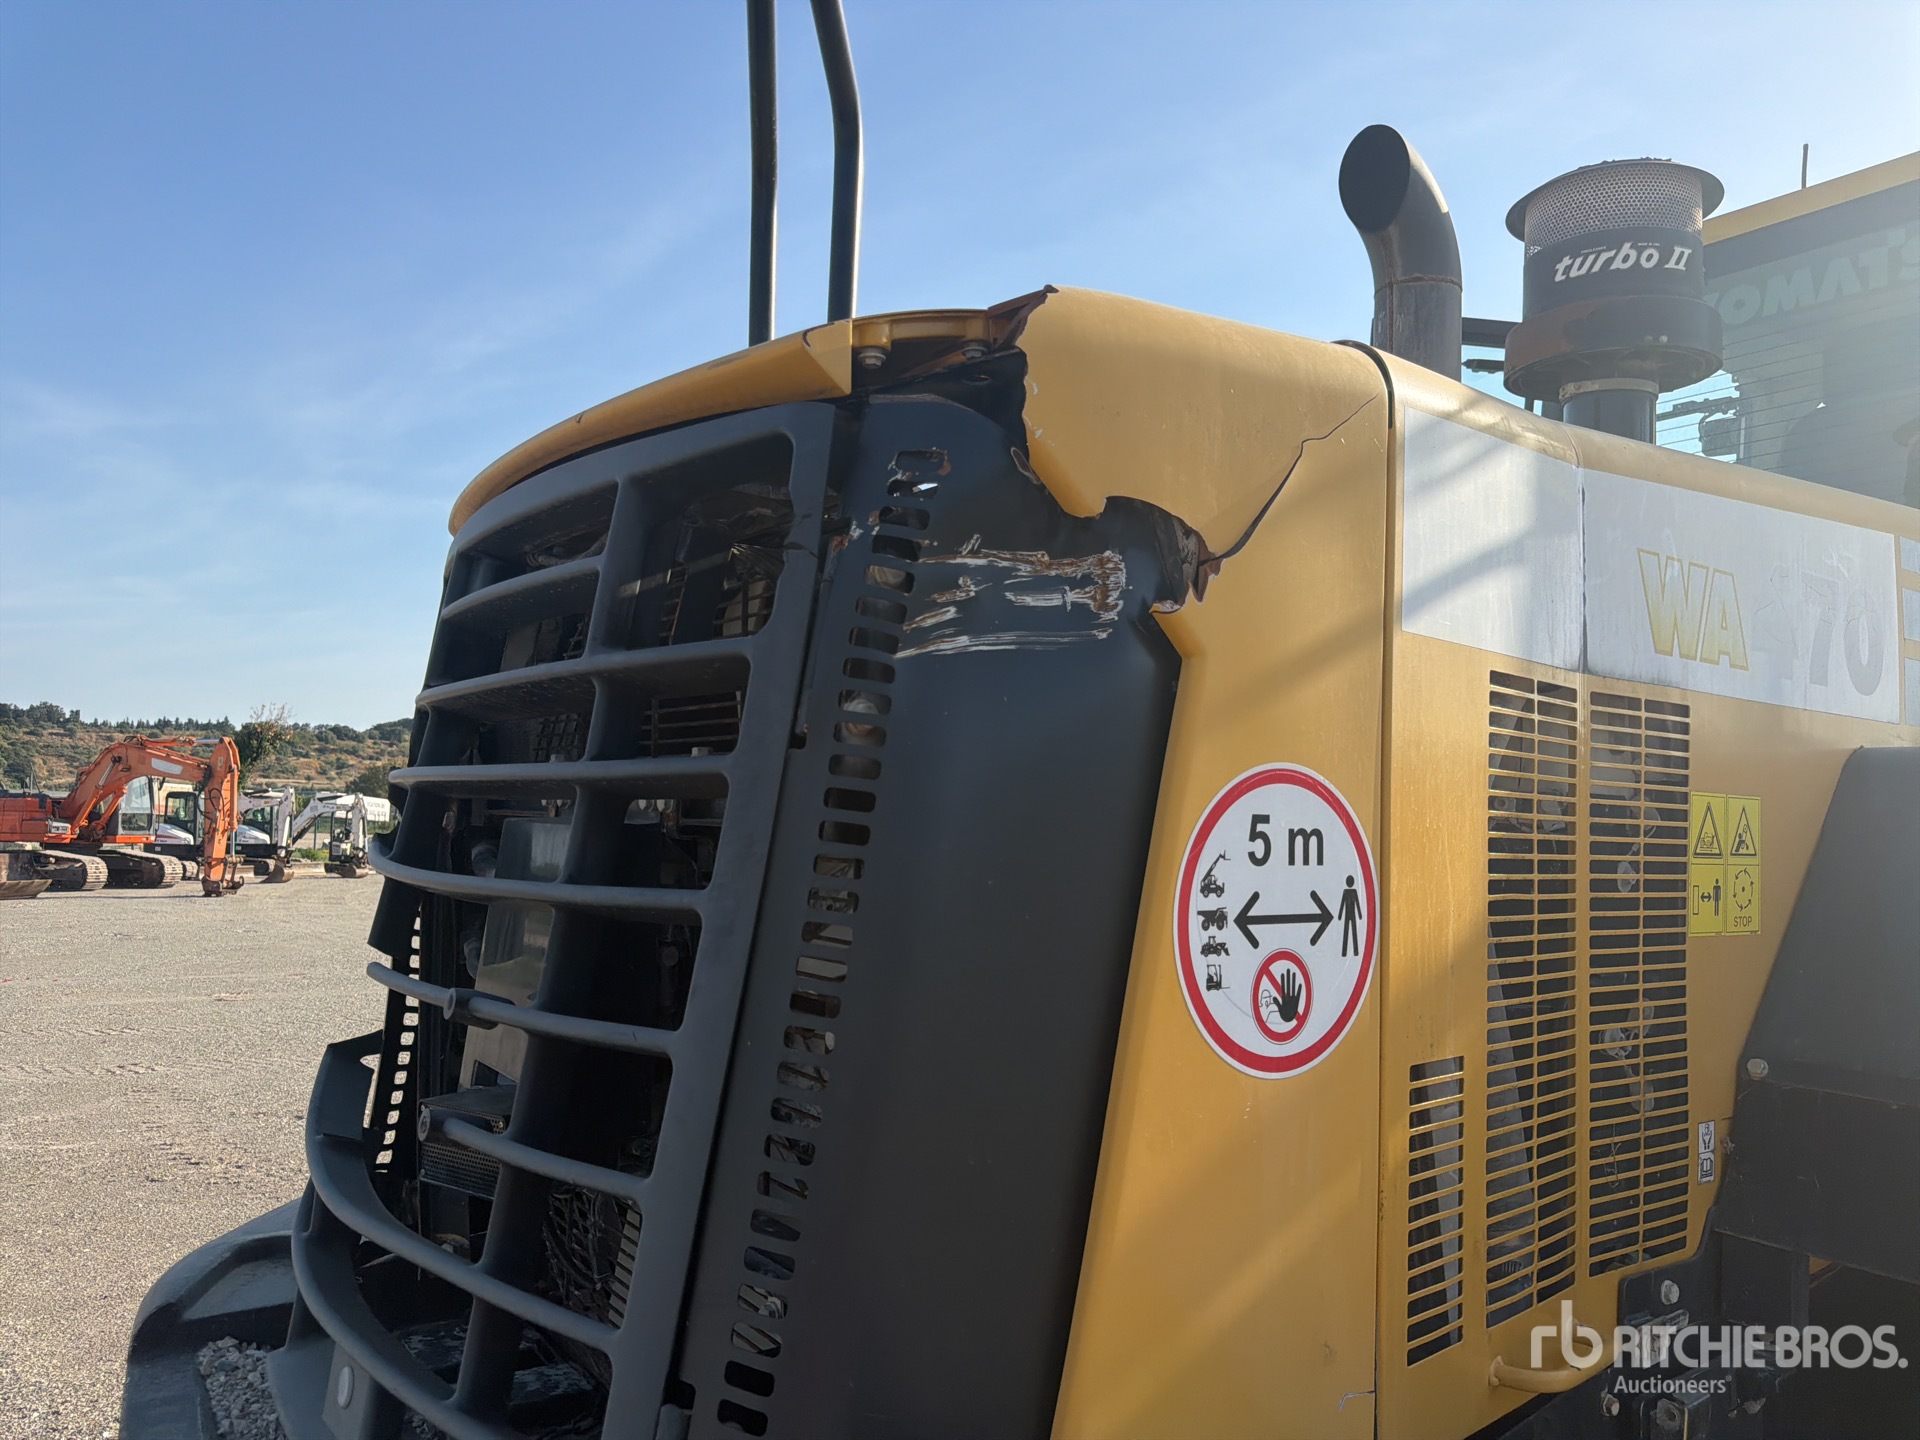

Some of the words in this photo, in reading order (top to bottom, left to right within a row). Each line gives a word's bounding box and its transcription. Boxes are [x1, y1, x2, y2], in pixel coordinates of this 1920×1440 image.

[1554, 241, 1660, 283] turbo
[1664, 245, 1692, 271] II
[1704, 229, 1920, 325] OMAT
[1637, 547, 1749, 672] WA
[1247, 814, 1271, 867] 5
[1288, 827, 1324, 866] m
[1733, 915, 1752, 928] STOP
